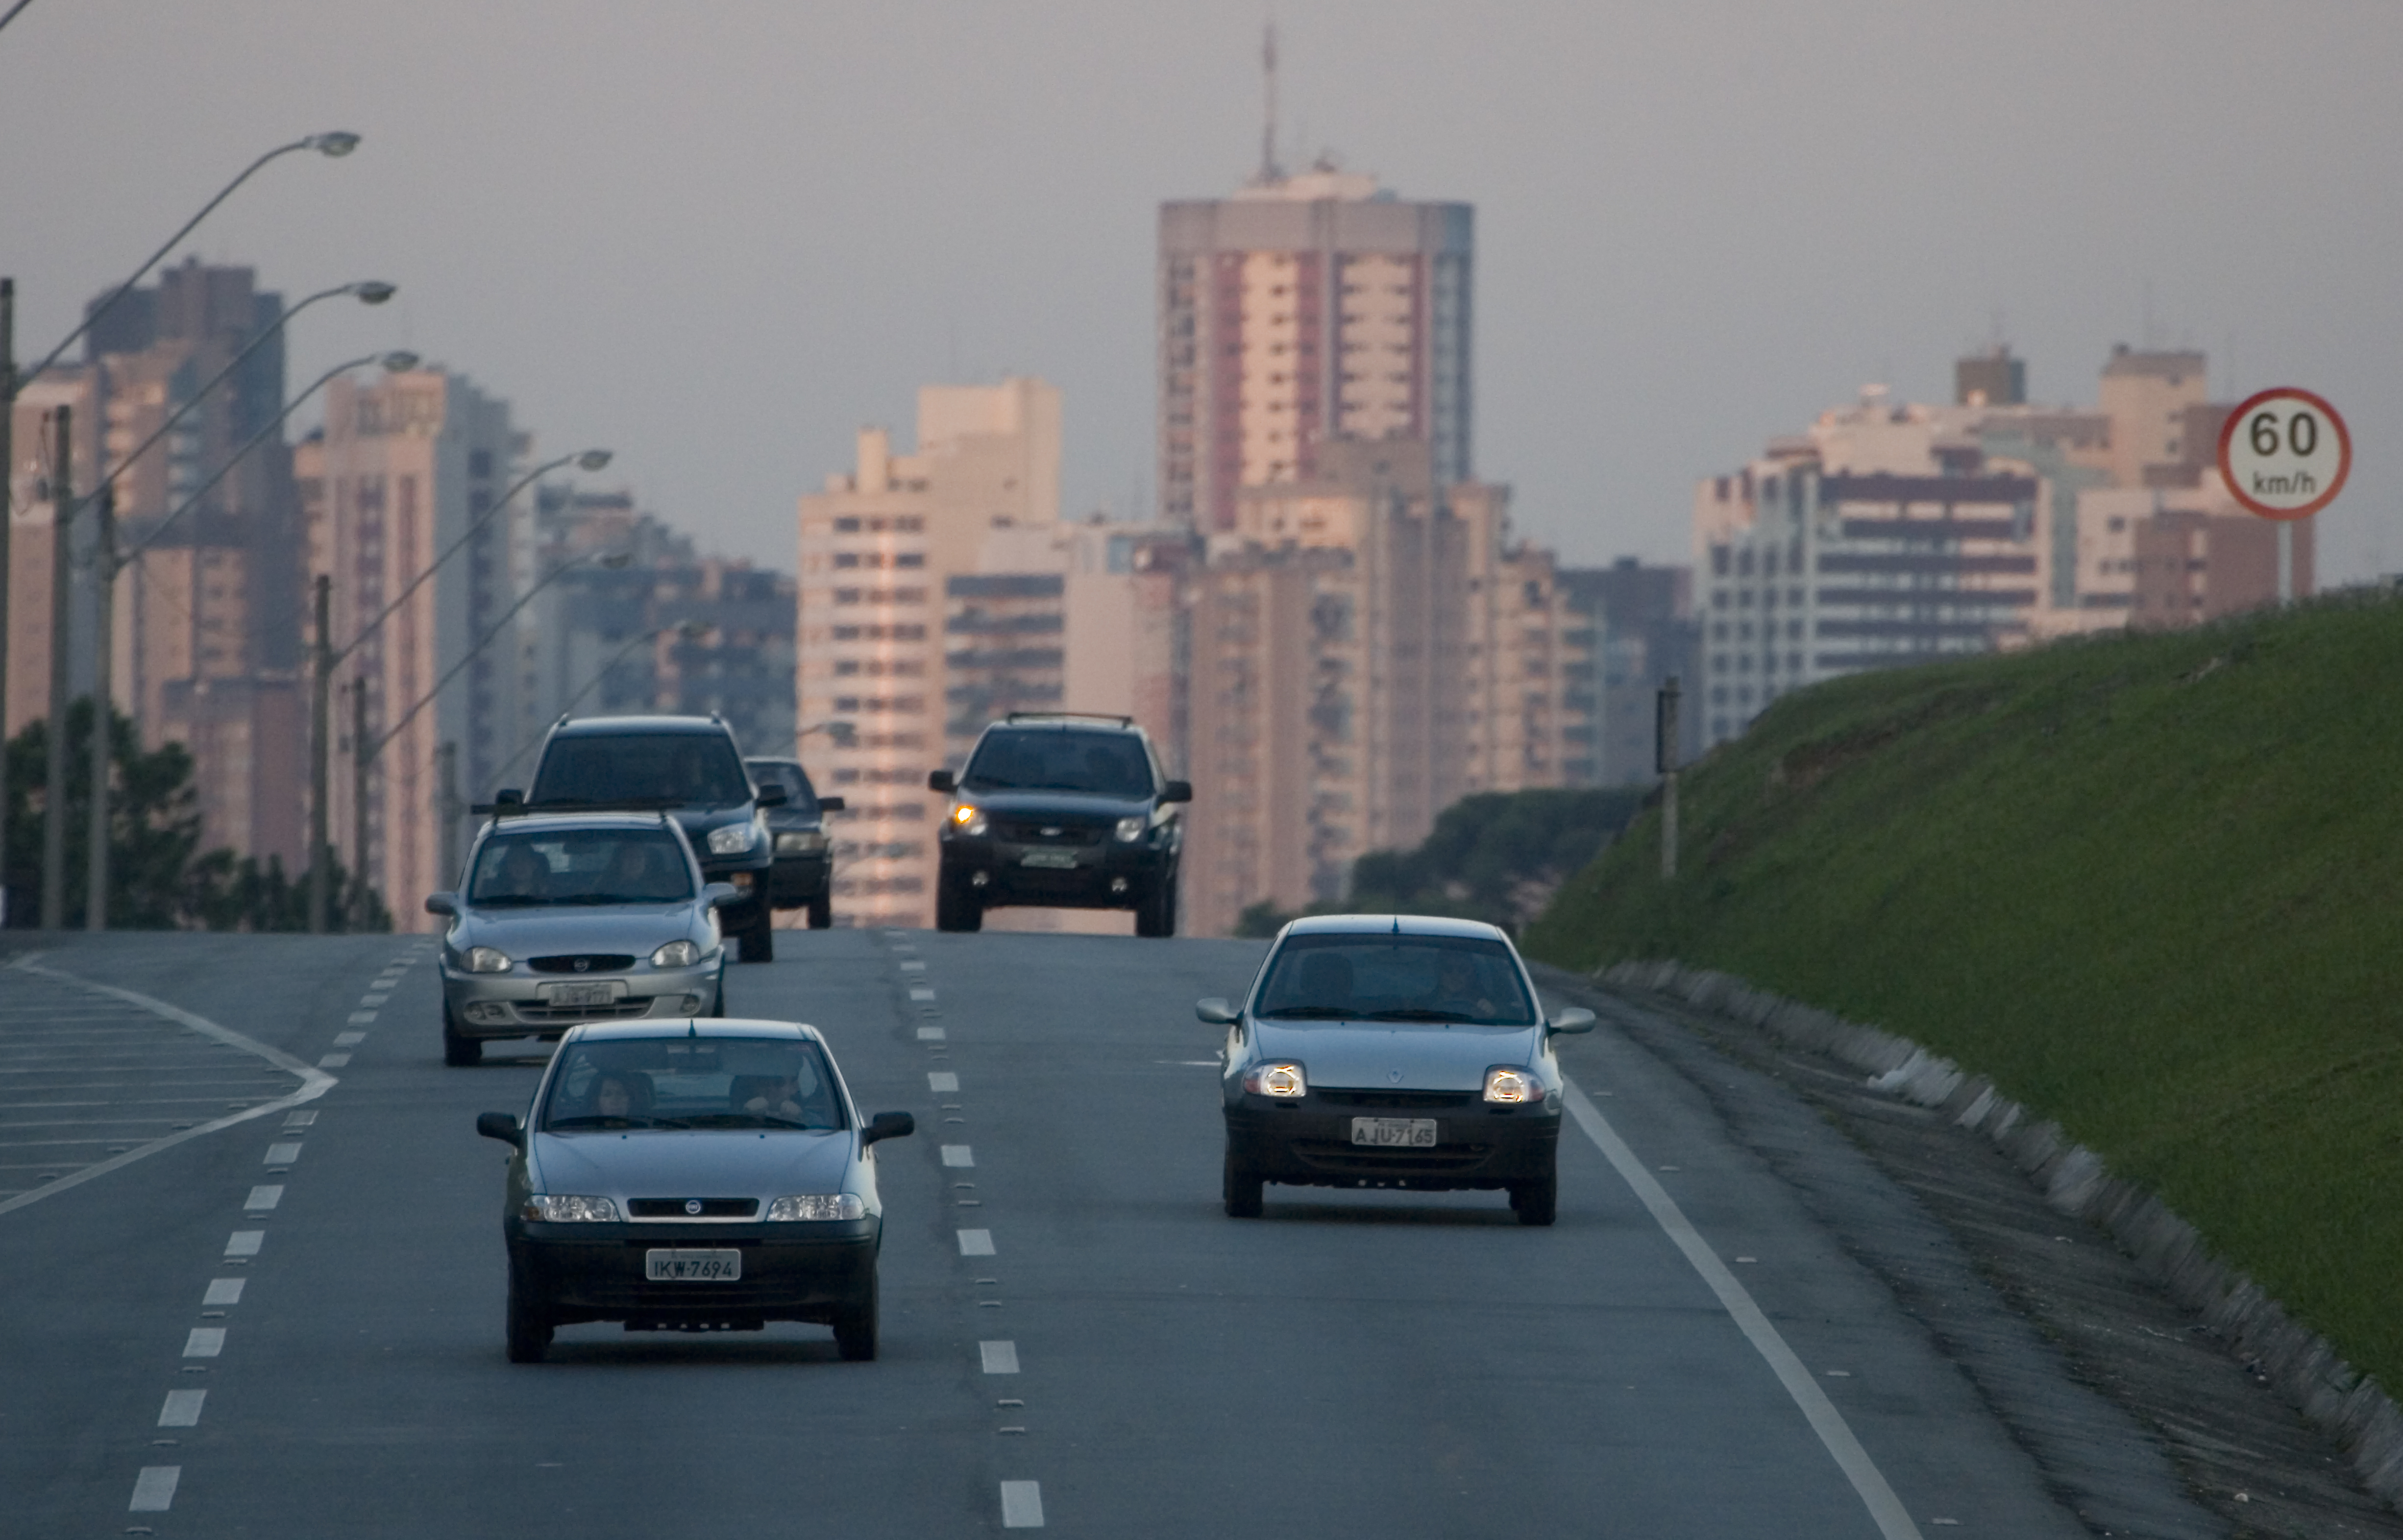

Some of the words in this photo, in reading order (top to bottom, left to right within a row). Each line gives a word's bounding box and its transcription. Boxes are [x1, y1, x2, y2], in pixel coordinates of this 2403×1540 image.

[2251, 412, 2317, 457] 60
[2253, 470, 2316, 493] km/h
[1354, 1127, 1433, 1144] AJU-7165
[654, 1261, 733, 1277] IKW-7694
